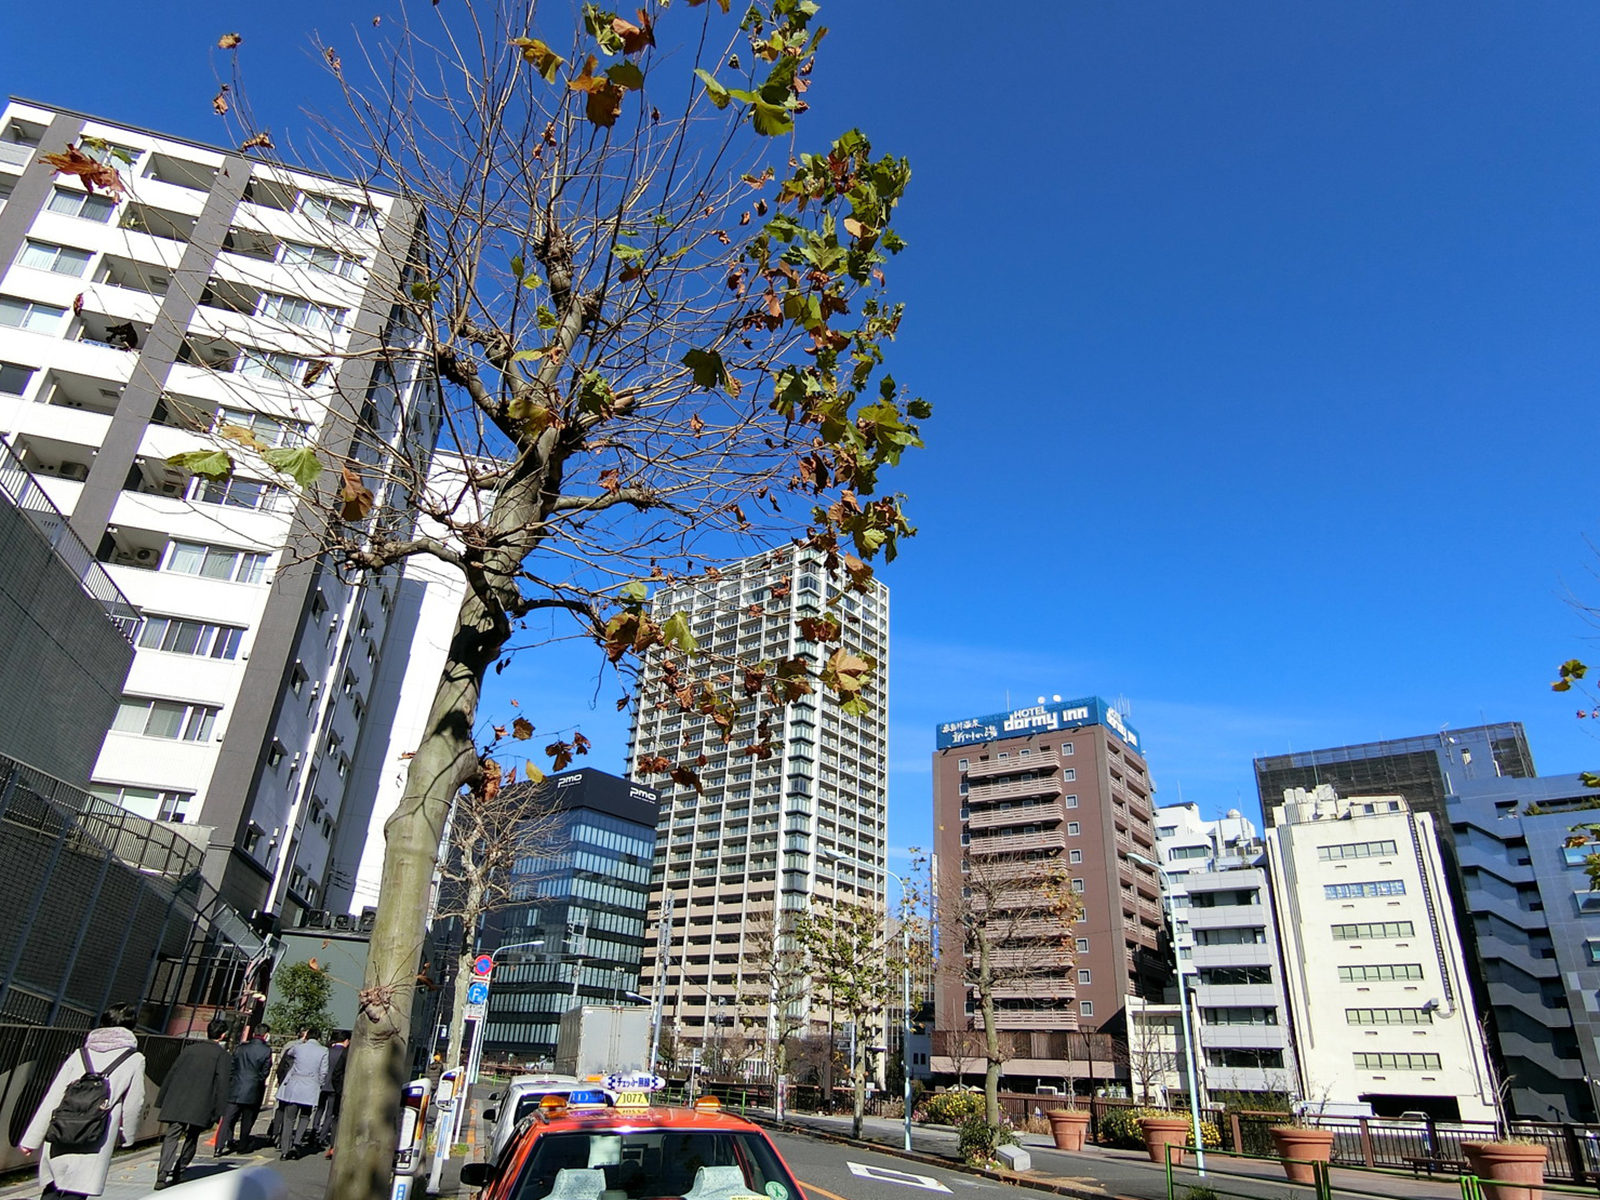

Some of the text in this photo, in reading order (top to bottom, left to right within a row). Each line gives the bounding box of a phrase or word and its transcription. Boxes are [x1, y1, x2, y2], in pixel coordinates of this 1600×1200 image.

[1003, 706, 1088, 731] dormy inn
[1013, 705, 1047, 719] HOTEL
[622, 1093, 643, 1103] 1077
